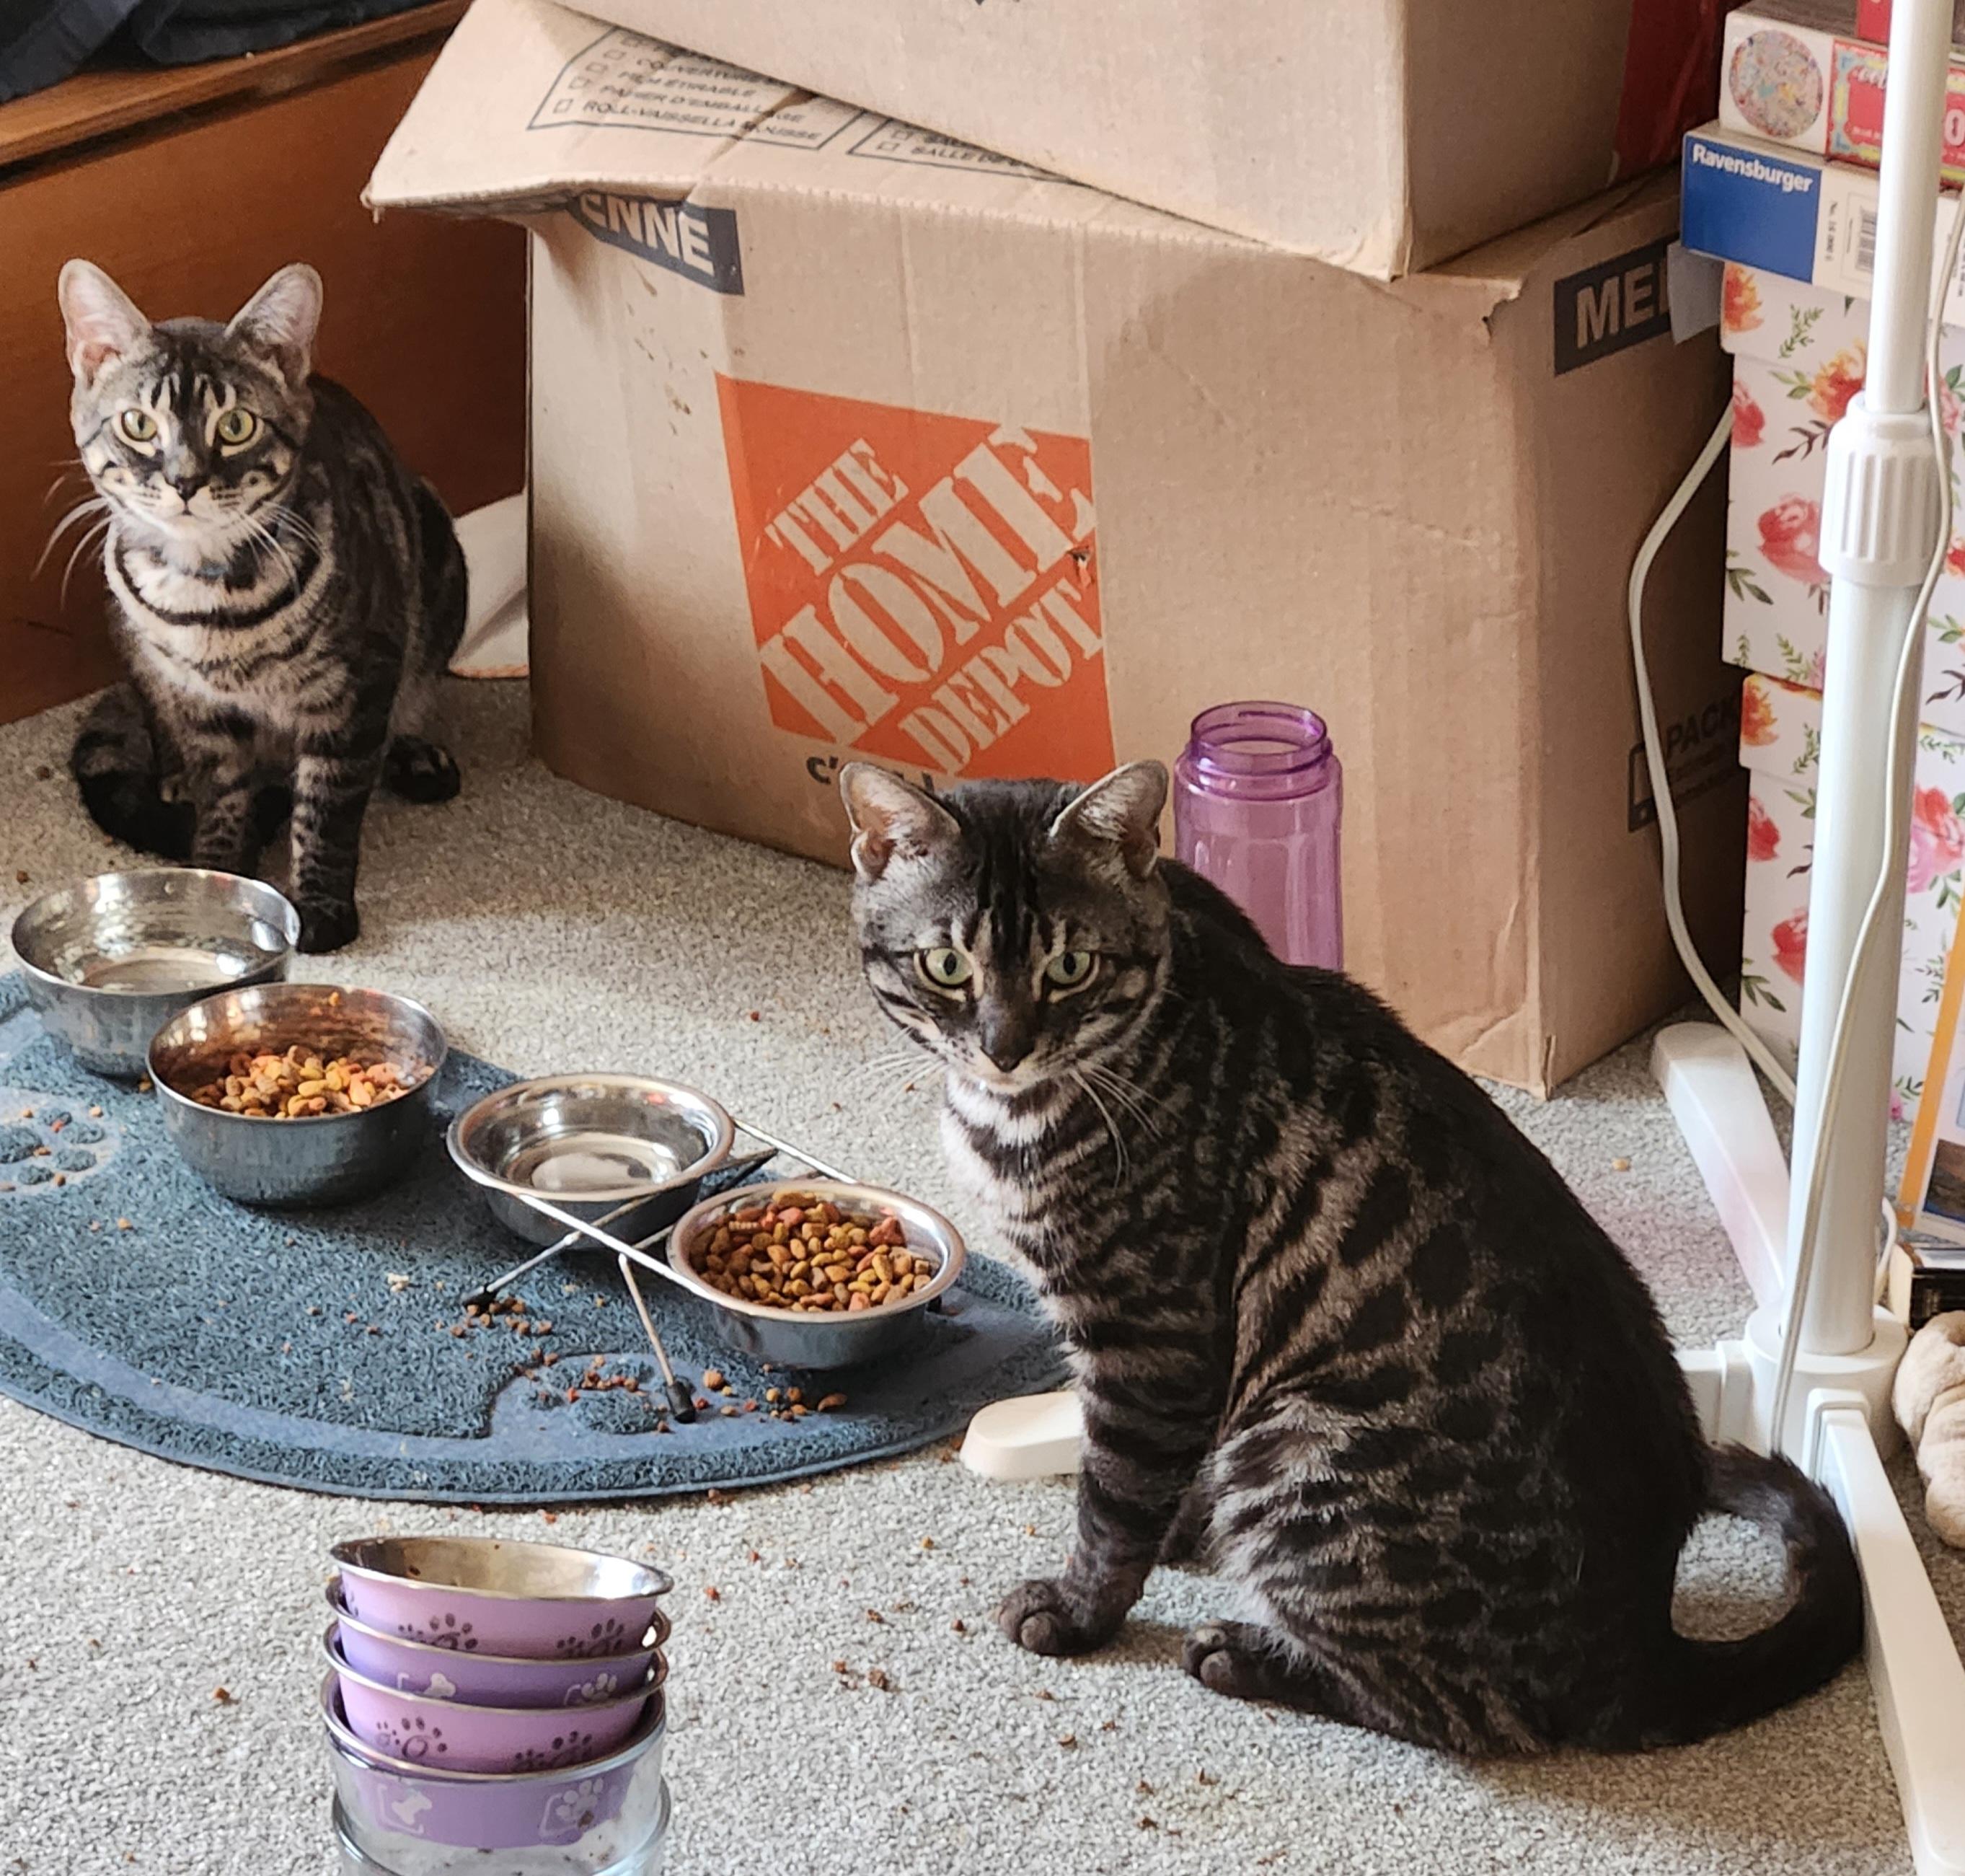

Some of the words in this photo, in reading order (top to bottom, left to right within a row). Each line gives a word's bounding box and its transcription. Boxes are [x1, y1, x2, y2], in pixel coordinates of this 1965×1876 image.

[1692, 143, 1813, 193] Ravensburger
[1576, 257, 1669, 350] ME
[764, 437, 910, 576] THE
[758, 426, 1097, 747] HOME
[897, 578, 1103, 778] DEPOT
